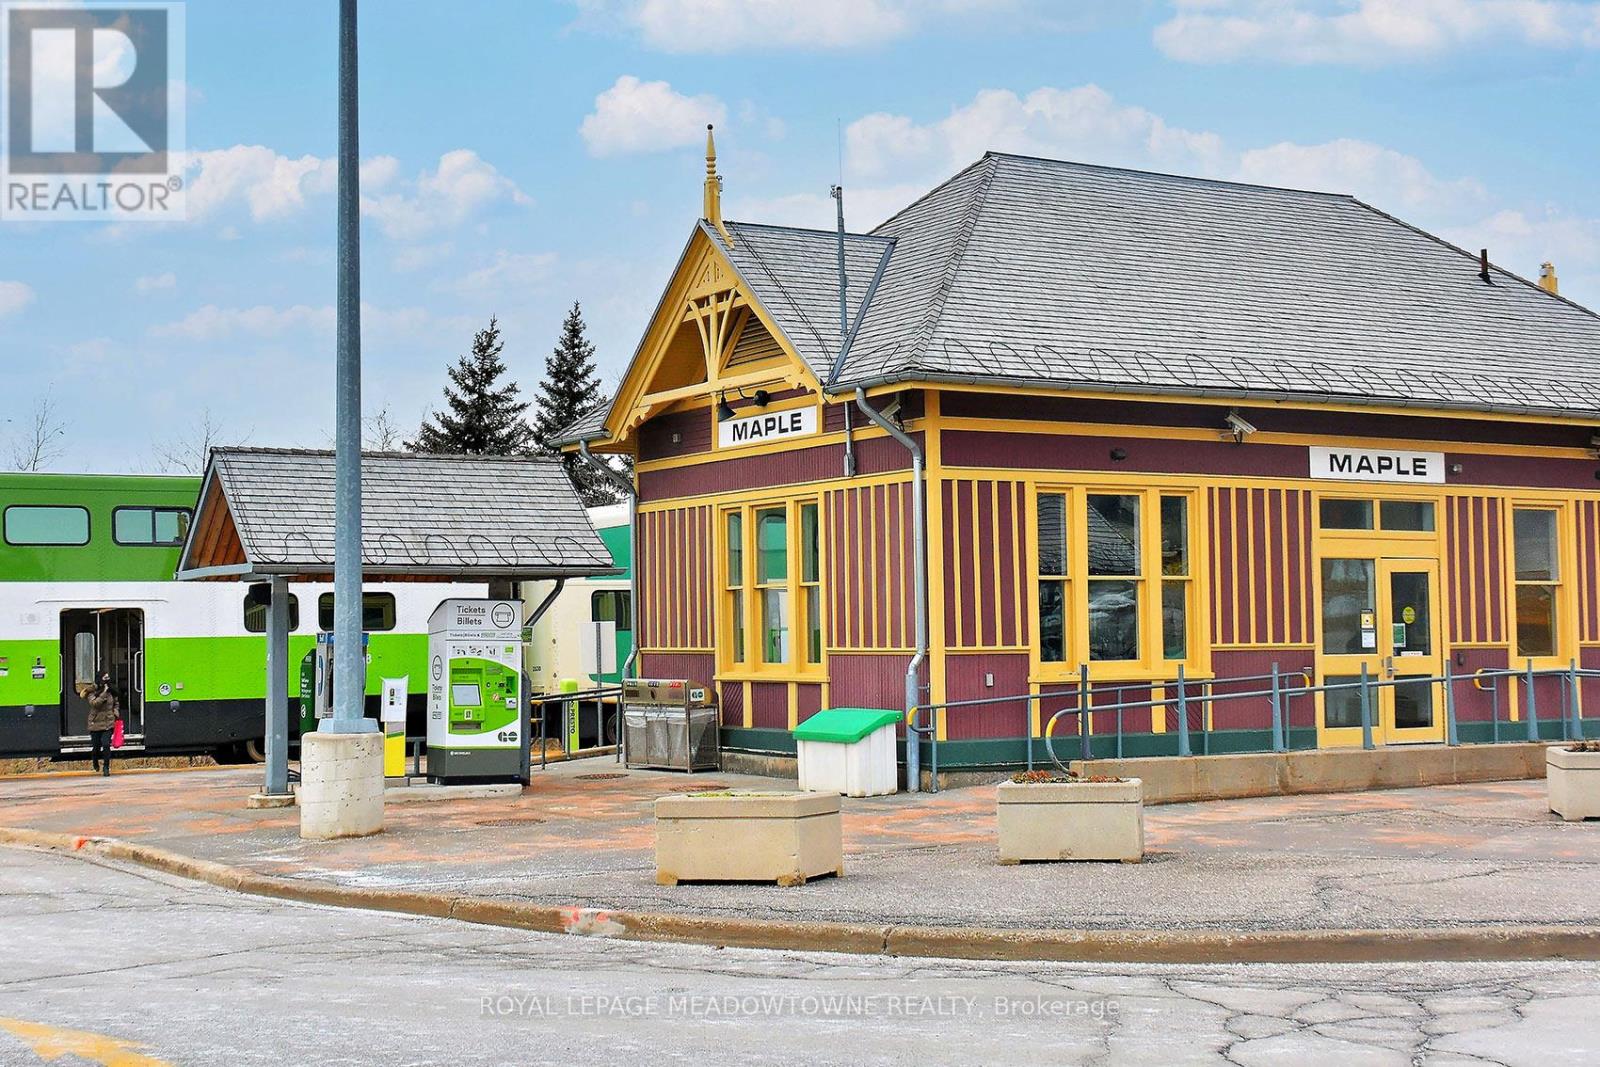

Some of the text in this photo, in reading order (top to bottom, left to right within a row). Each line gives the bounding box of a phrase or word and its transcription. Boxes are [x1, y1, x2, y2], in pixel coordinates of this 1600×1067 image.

[732, 412, 803, 442] MAPLE
[1329, 453, 1427, 476] MAPLE
[457, 605, 486, 614] Tickets
[457, 617, 482, 625] Billets
[691, 691, 704, 699] GO
[497, 731, 518, 742] GO
